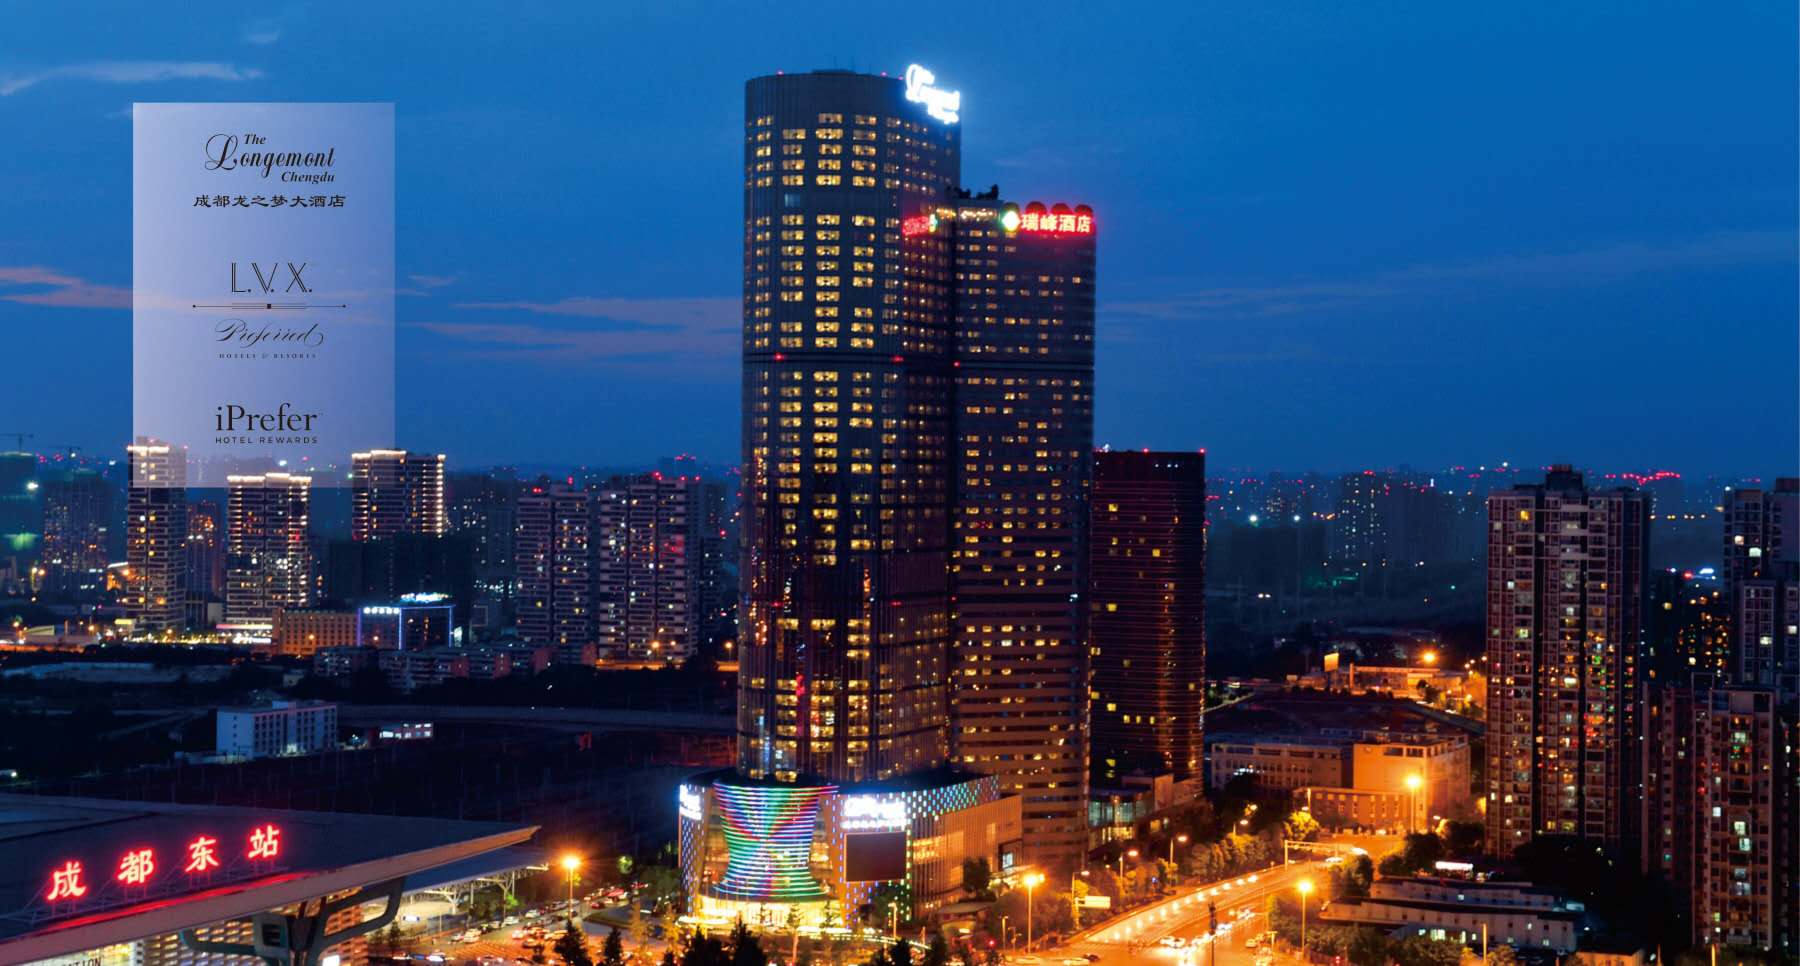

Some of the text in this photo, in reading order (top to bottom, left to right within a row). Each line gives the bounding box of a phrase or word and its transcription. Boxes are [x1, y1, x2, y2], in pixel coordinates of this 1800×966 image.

[1021, 212, 1091, 233] 瑞峰酒店
[47, 825, 281, 900] 成都东站
